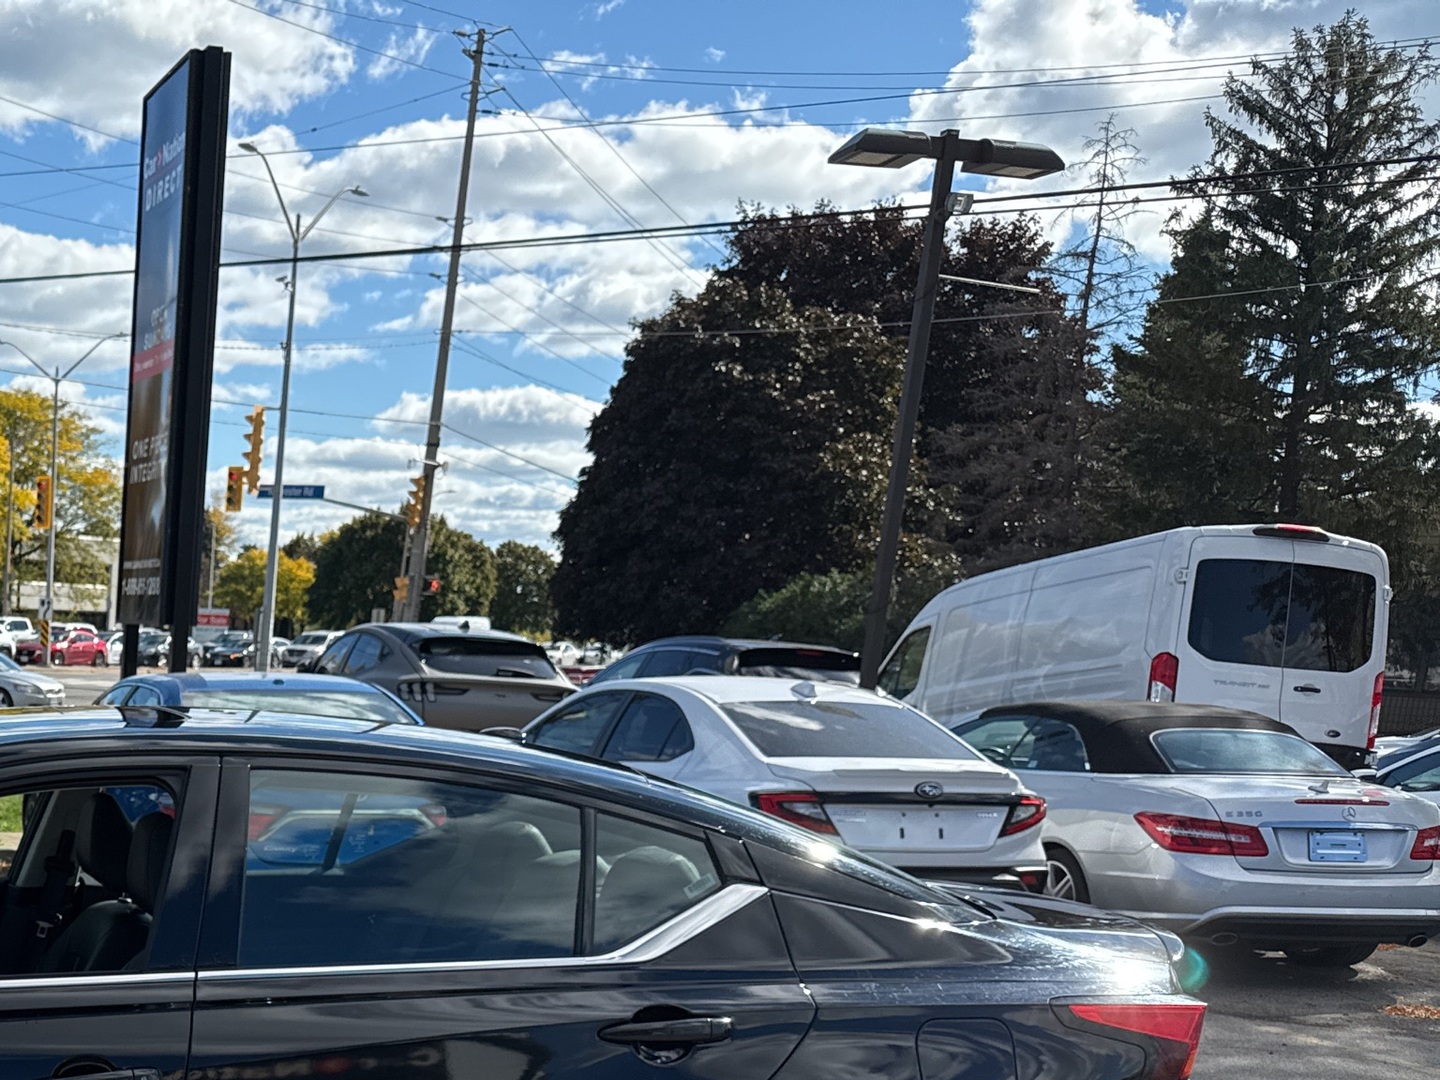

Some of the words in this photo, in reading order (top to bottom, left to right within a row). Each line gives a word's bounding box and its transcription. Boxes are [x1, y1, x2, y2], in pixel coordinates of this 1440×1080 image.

[143, 157, 157, 179] Car
[163, 131, 185, 167] Nation
[145, 163, 183, 212] DIRECT
[132, 439, 149, 460] ONE
[303, 487, 315, 497] Rd
